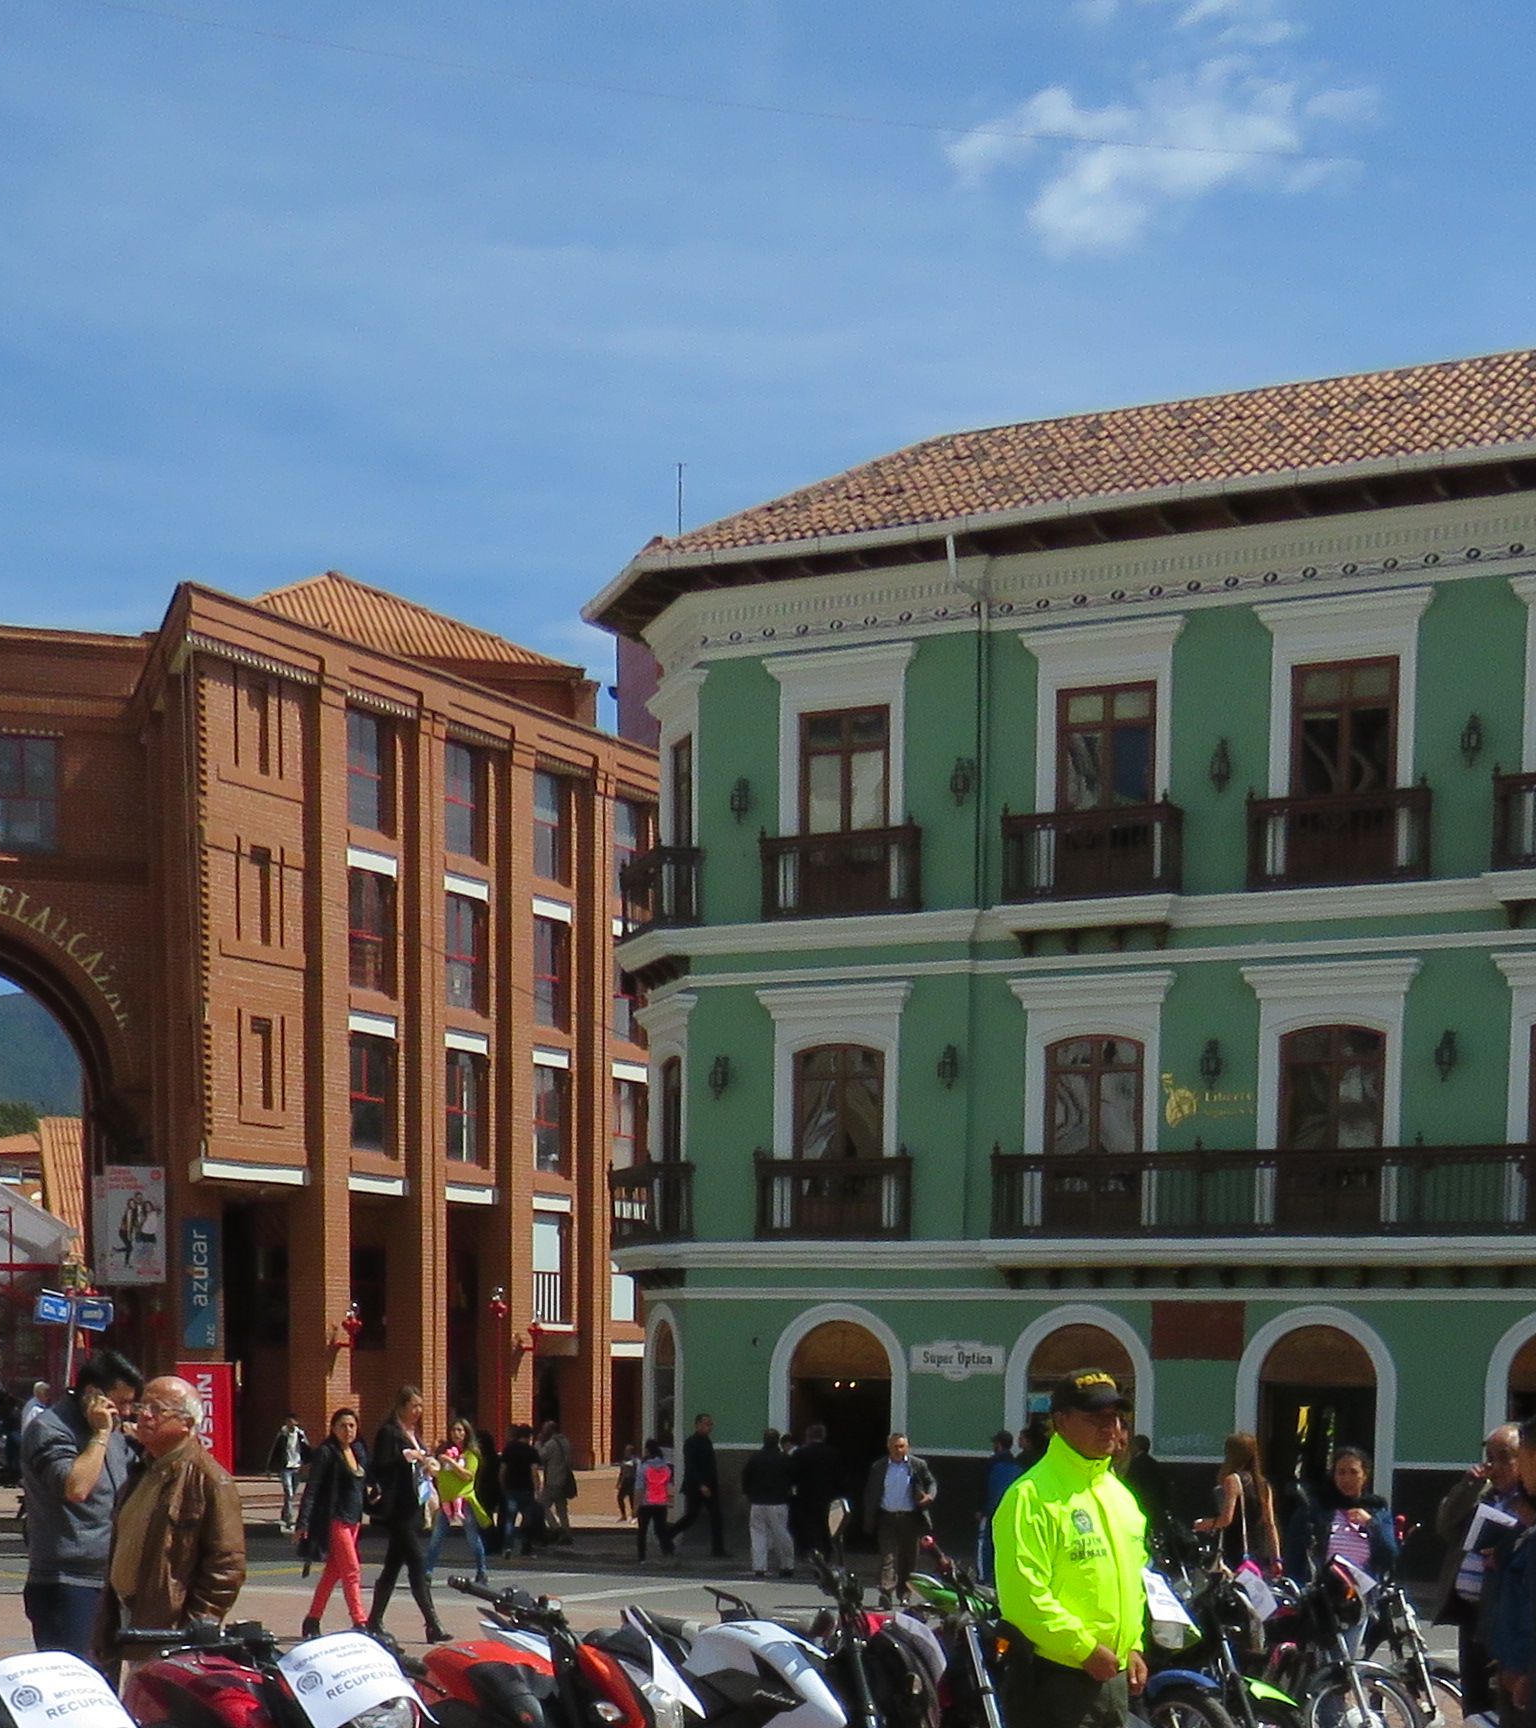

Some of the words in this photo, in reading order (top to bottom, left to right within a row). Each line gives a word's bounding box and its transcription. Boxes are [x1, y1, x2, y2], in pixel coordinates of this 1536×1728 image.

[922, 1351, 954, 1368] Super
[1074, 1372, 1117, 1390] POLI
[196, 1373, 214, 1452] NISSA
[325, 1669, 403, 1700] RECUPERA
[45, 1696, 120, 1720] RECUPE
